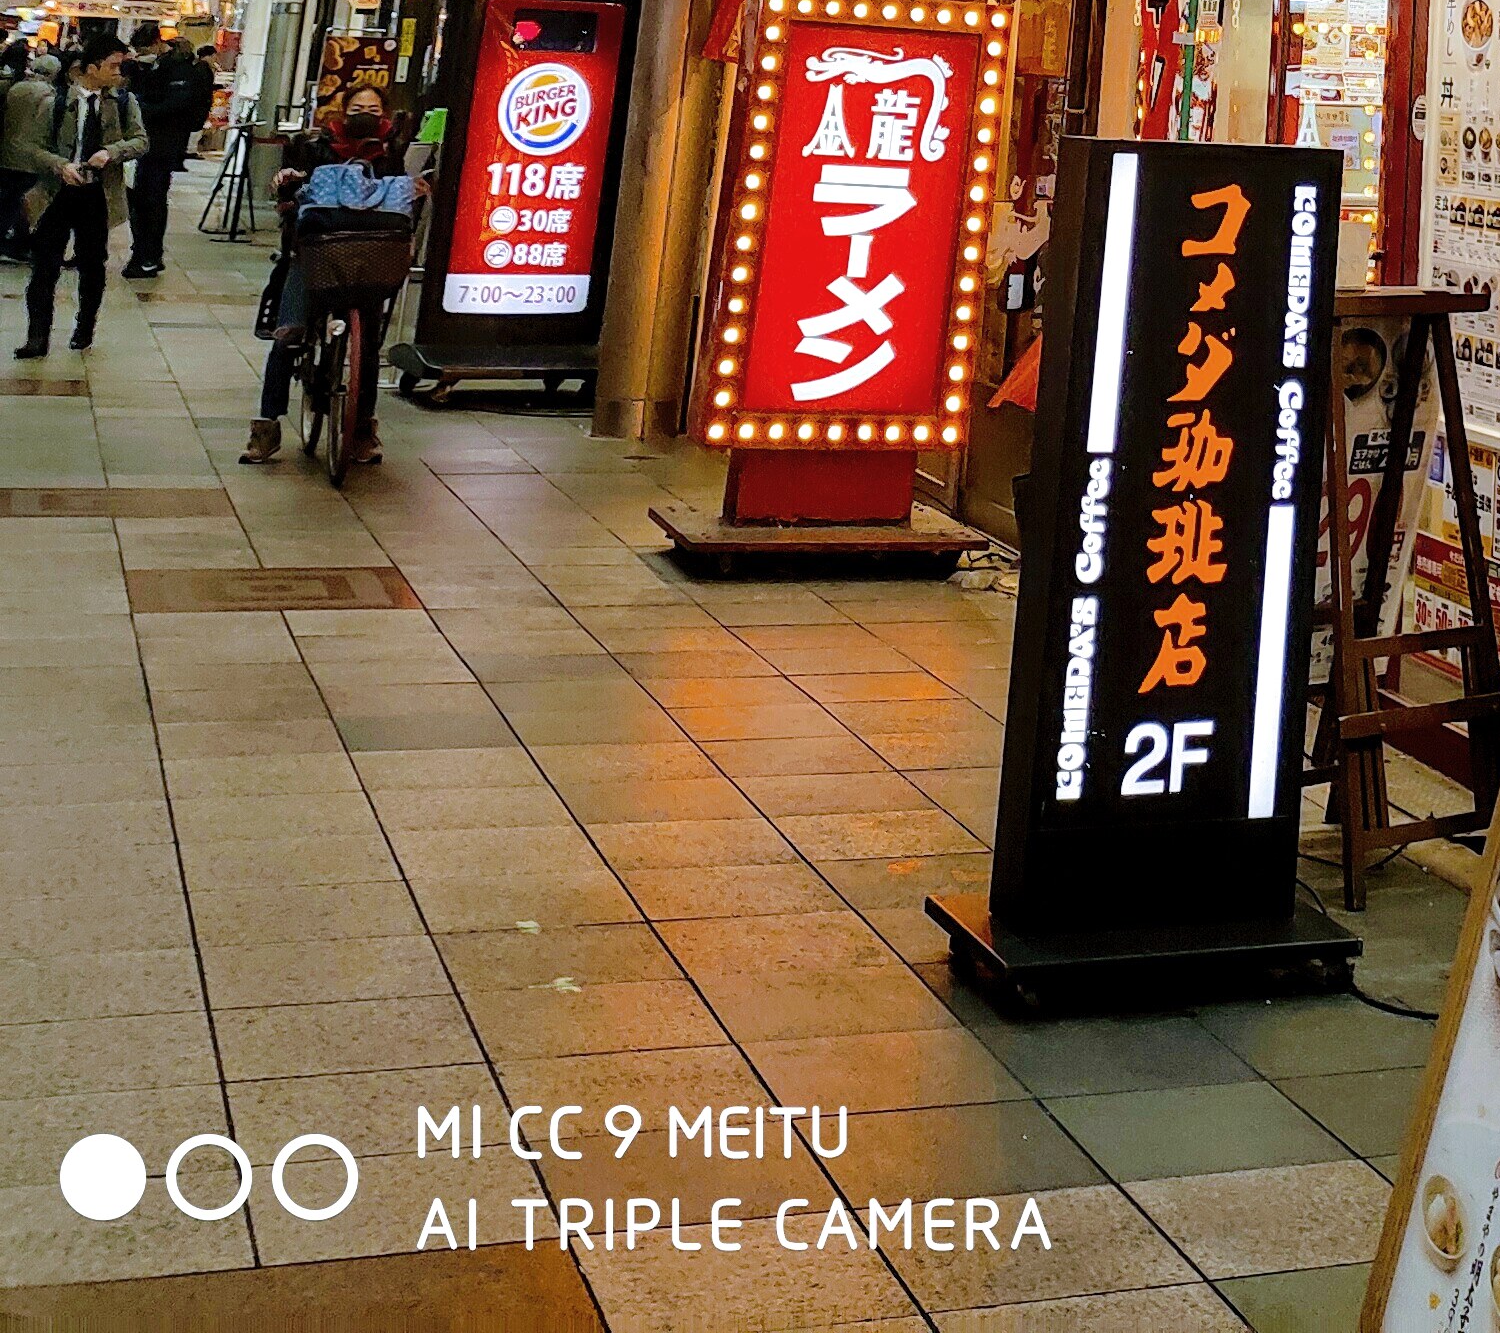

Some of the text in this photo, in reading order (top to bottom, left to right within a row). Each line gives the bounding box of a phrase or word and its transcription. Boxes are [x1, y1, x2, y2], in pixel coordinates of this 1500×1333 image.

[514, 84, 576, 111] BURGER
[514, 97, 577, 133] KING
[802, 84, 920, 162] 金龍
[487, 162, 586, 200] 118席
[513, 242, 567, 267] 88席
[518, 208, 572, 233] 30席
[790, 165, 917, 401] ラーメン
[1271, 184, 1318, 501] KOMEDA'S Coffee
[1138, 183, 1252, 694] コメダ珈琲店
[1055, 454, 1113, 802] KOMEDA'S Coffee
[1120, 720, 1215, 799] 2F
